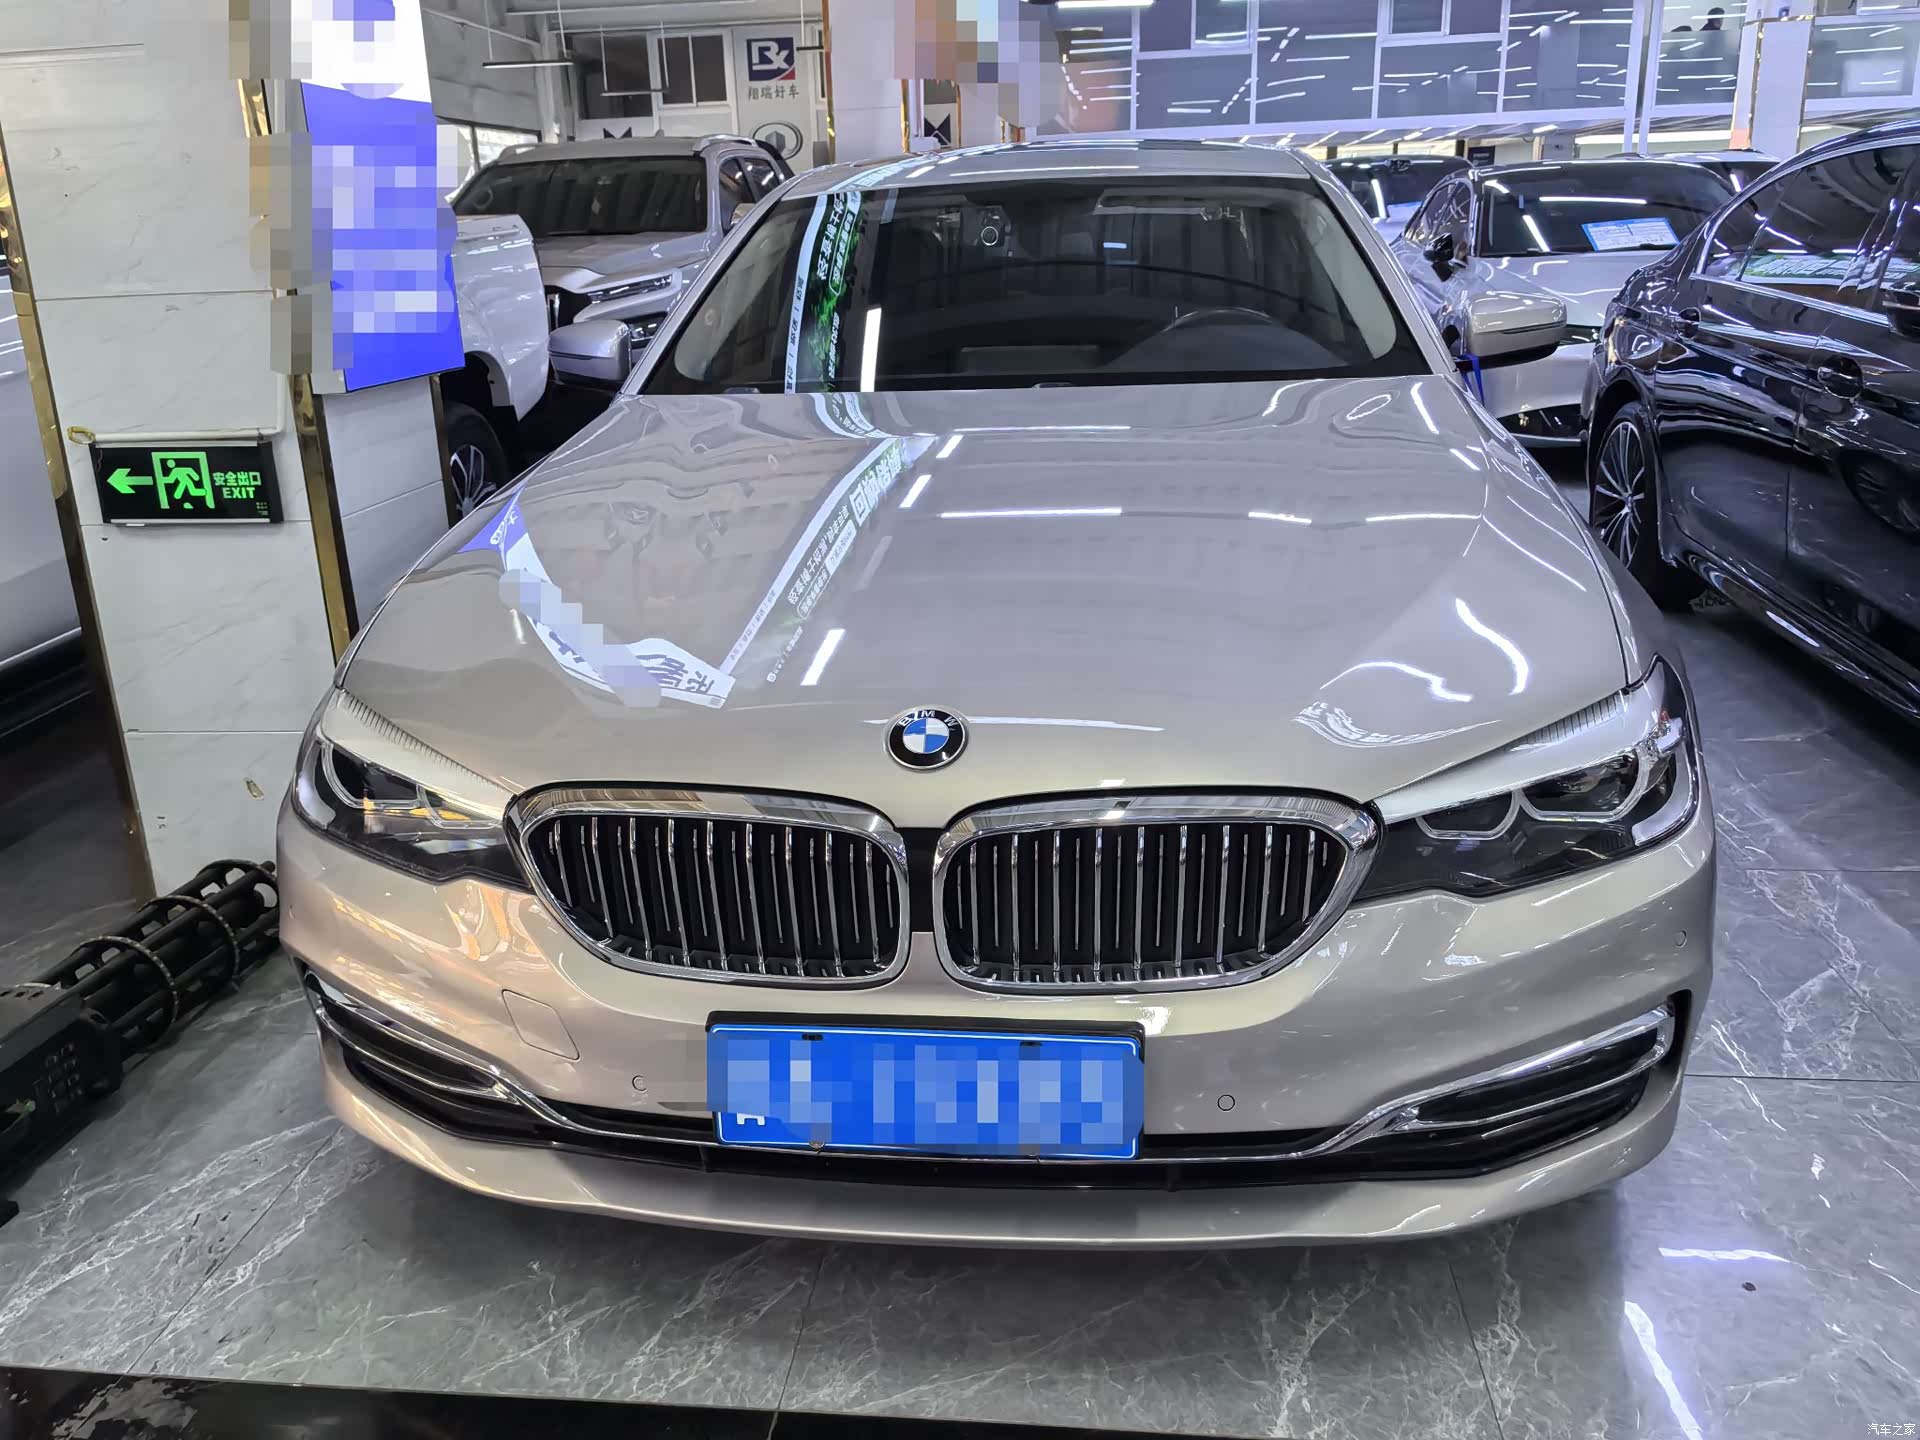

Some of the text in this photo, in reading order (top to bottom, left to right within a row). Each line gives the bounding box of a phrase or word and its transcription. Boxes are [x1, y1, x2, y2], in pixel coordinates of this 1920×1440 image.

[212, 471, 262, 486] 安全出口
[222, 487, 256, 499] EXIT
[898, 709, 959, 727] BMW
